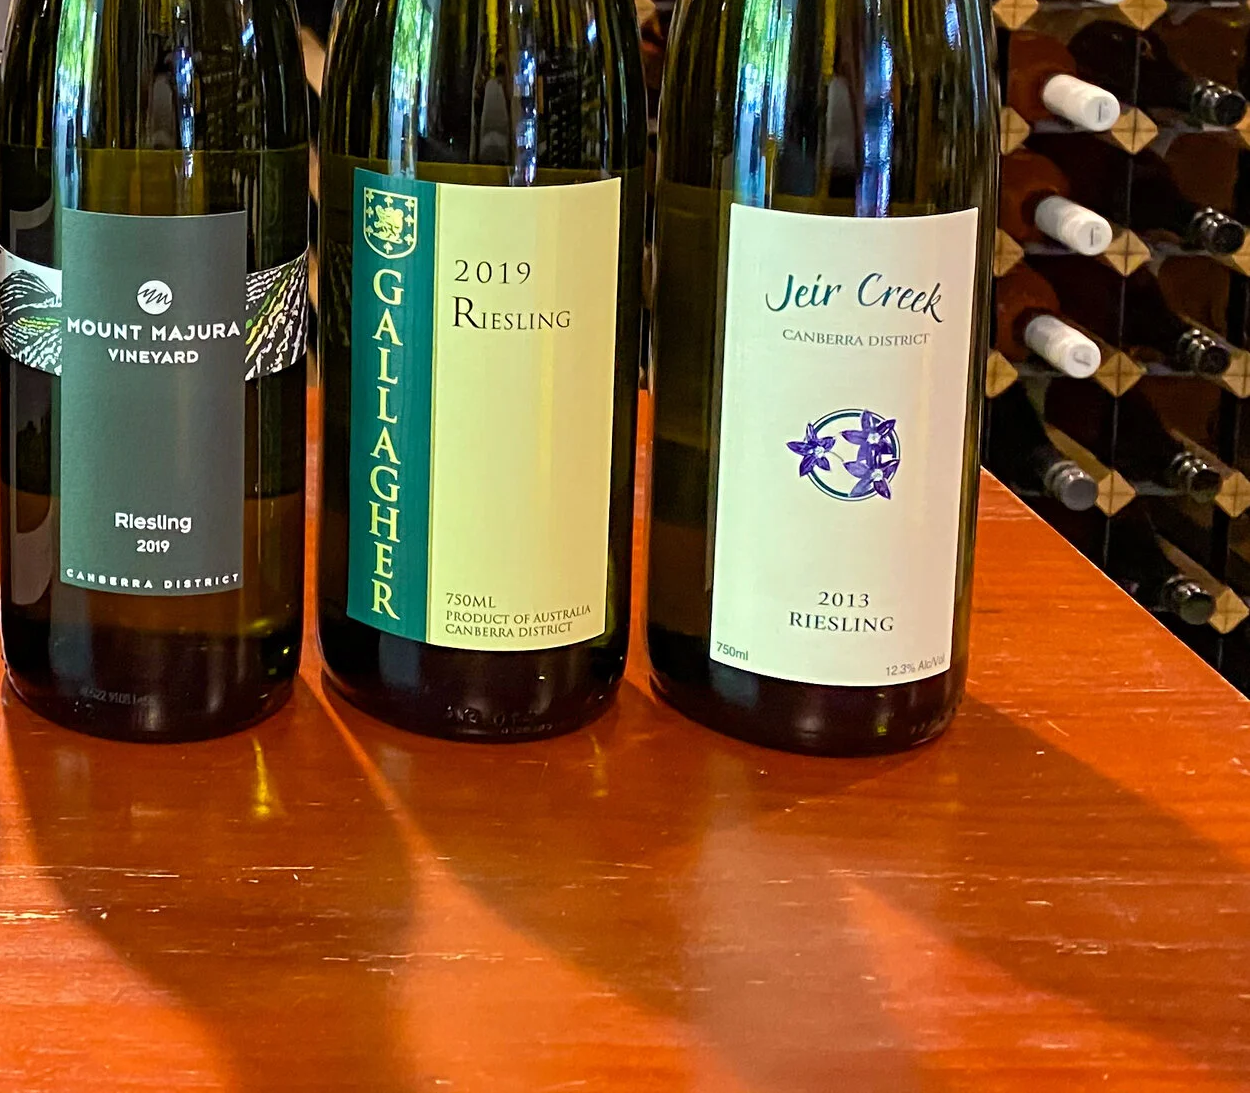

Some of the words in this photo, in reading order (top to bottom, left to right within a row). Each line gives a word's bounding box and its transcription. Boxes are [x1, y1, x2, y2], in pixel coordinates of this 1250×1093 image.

[454, 259, 531, 284] 2019
[765, 274, 842, 312] Jeir
[857, 272, 944, 323] Creek
[67, 316, 143, 341] MOUNT
[151, 321, 241, 342] MAJURA
[782, 329, 863, 346] CANBERRA
[869, 333, 931, 347] DISTRICT
[108, 348, 199, 364] VINEYARD
[369, 269, 404, 620] GALLAGHER
[115, 512, 192, 534] Riesling
[136, 539, 170, 553] 2019
[66, 568, 153, 589] CANBERRA
[164, 573, 239, 589] DISTRICT
[445, 592, 496, 608] 750ML
[818, 591, 870, 608] 2013
[446, 610, 510, 625] PRODUCT
[513, 614, 531, 624] OF
[533, 604, 591, 623] AUSTRALIA
[790, 611, 894, 632] RIESLING
[445, 624, 514, 637] CANBERRA
[518, 621, 573, 637] DISTRICT
[716, 641, 749, 661] 750ml
